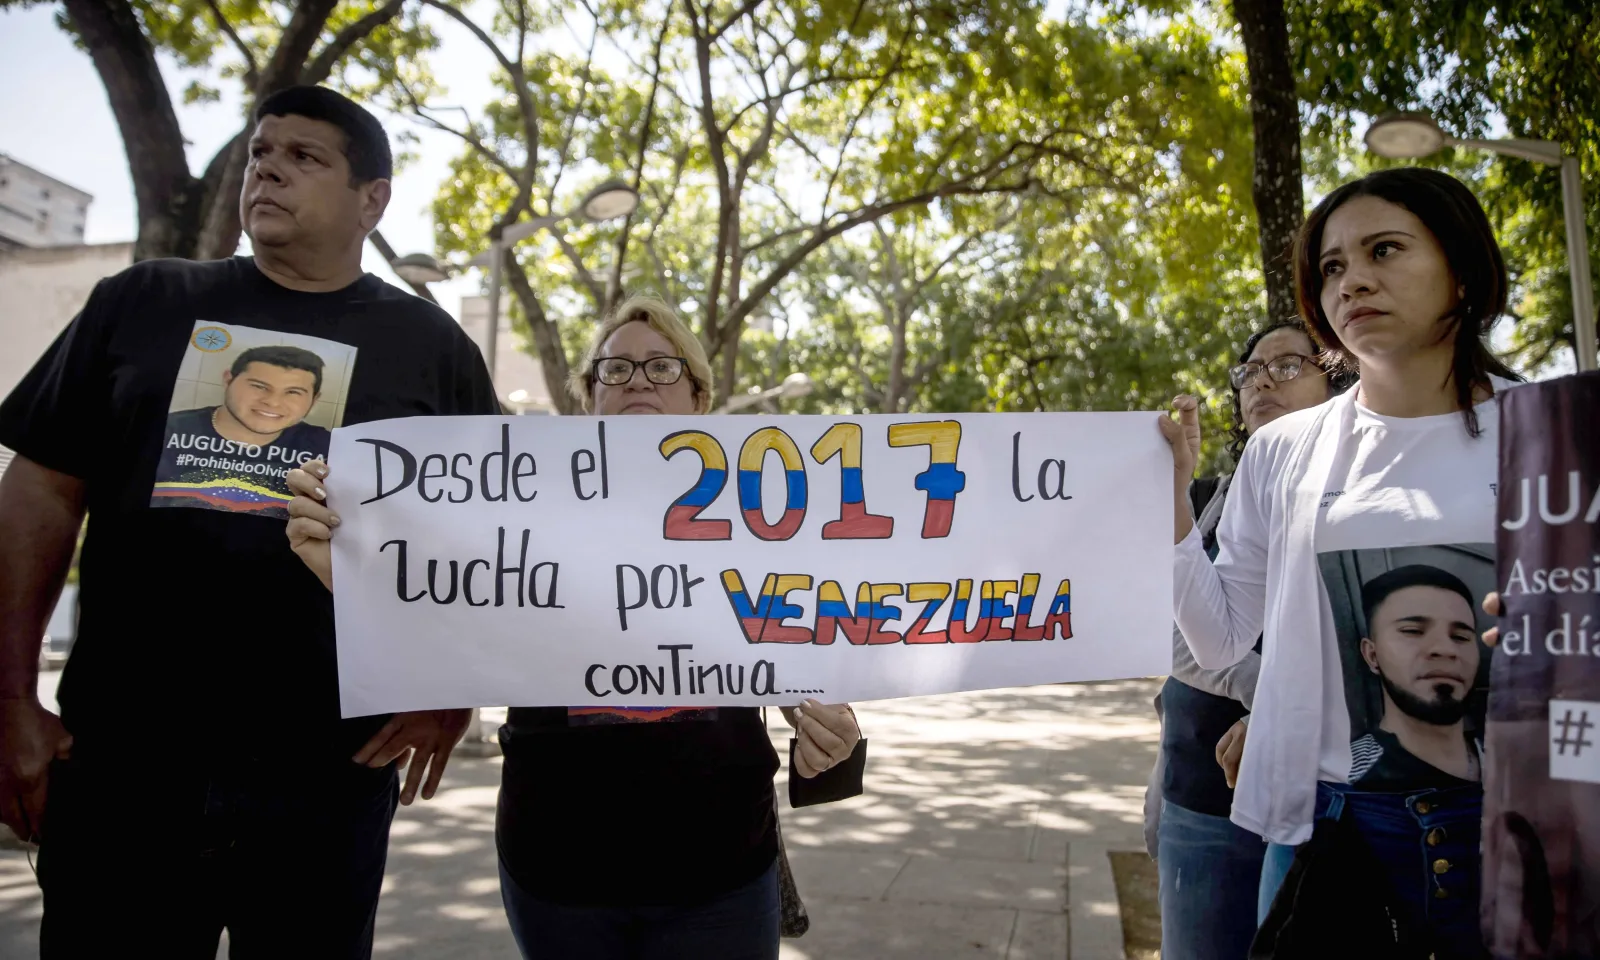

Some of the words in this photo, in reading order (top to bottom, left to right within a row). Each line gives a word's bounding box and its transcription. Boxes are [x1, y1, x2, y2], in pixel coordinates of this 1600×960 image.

[167, 433, 262, 458] AUGUSTO
[176, 454, 291, 479] #ProhibidoOlvid
[355, 423, 538, 505] Desde
[571, 421, 609, 500] el
[658, 420, 966, 541] 2017
[1011, 431, 1073, 502] la
[615, 563, 706, 631] por
[720, 569, 1073, 645] VENEZUELA
[1502, 613, 1532, 656] el
